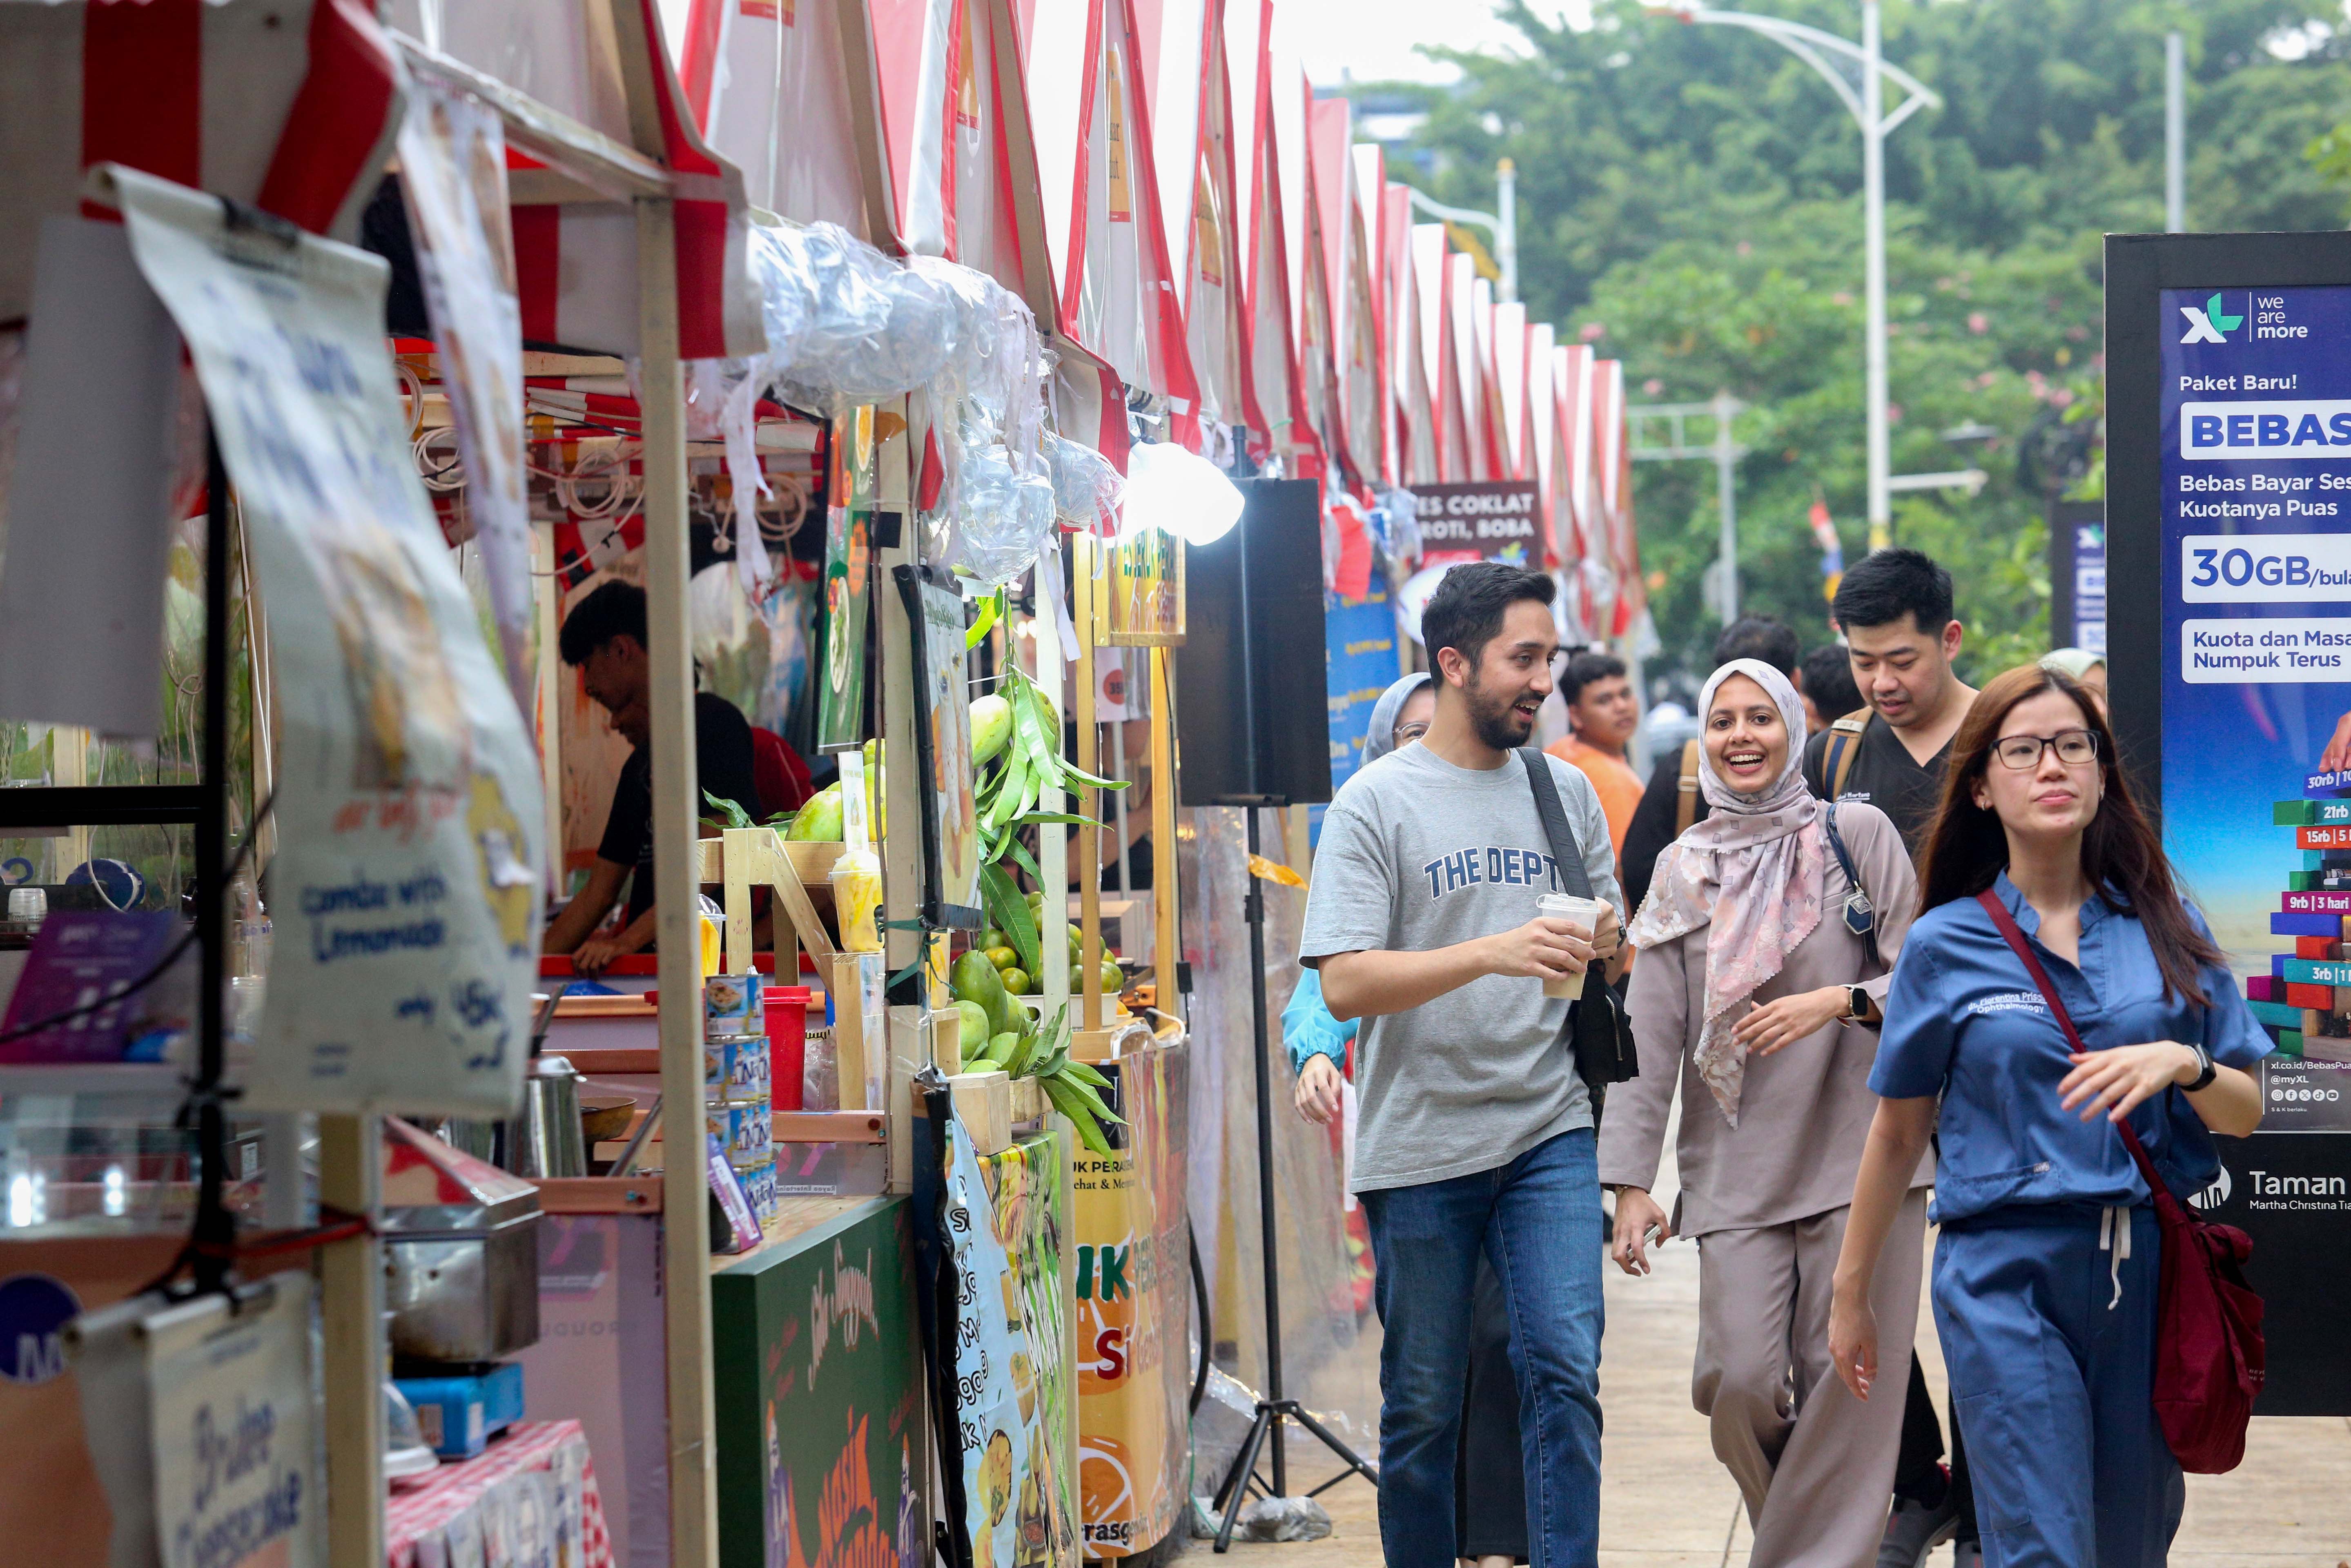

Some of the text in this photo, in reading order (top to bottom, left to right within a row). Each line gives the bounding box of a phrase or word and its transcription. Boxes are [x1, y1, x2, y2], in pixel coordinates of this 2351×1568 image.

[2257, 297, 2284, 308] we
[2257, 311, 2286, 323] are
[2257, 326, 2308, 338] more
[2180, 374, 2297, 391] Paket Baru!
[2192, 412, 2351, 447] BEBAS
[2180, 474, 2246, 492] Bebas
[2251, 474, 2313, 494] Bayar
[1446, 493, 1534, 516] COKLAT
[2180, 499, 2338, 520] Kuotanya Puas
[1476, 517, 1535, 538] BOBA
[2194, 631, 2253, 647] Kuota
[2260, 630, 2298, 646] dan
[2194, 651, 2341, 671] Numpuk Terus
[2307, 773, 2335, 789] 30rb
[2324, 804, 2349, 819] 21rb
[2306, 829, 2331, 843] 15rb
[1423, 846, 1482, 900] THE
[2290, 896, 2349, 909] 9rb 3 hari
[2313, 967, 2332, 980] 3rb
[1980, 993, 2020, 1005] Florentina
[1977, 1002, 2044, 1013] Ophthalmology
[2271, 1075, 2309, 1085] @myXL
[1101, 1180, 1110, 1189] &
[2249, 1171, 2345, 1195] Taman
[2250, 1200, 2287, 1209] Martha
